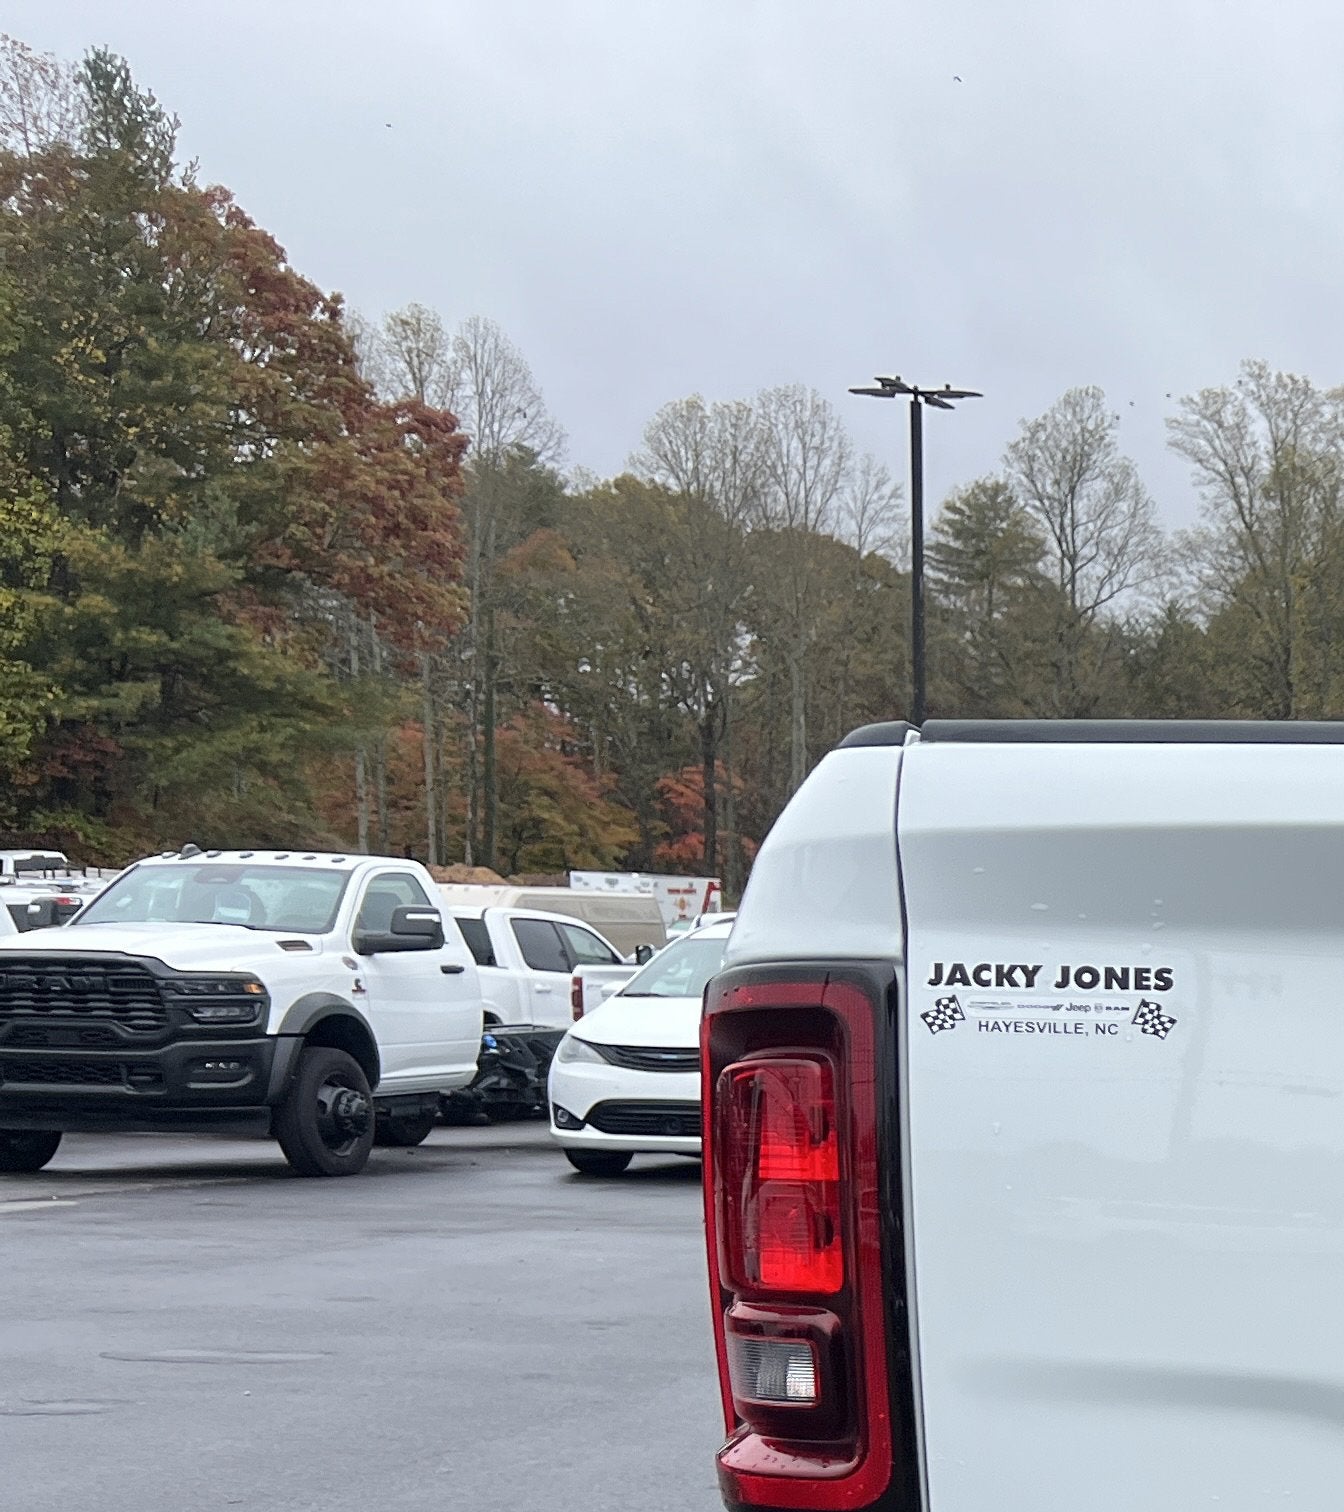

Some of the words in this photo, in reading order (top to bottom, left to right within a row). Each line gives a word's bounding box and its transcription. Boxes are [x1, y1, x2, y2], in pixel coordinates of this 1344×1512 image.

[927, 962, 1043, 988] JACKY
[1054, 965, 1174, 991] JONES
[1065, 1002, 1092, 1013] Jeep
[978, 1020, 1089, 1036] HAYESVILLE,
[1094, 1023, 1120, 1035] NC
